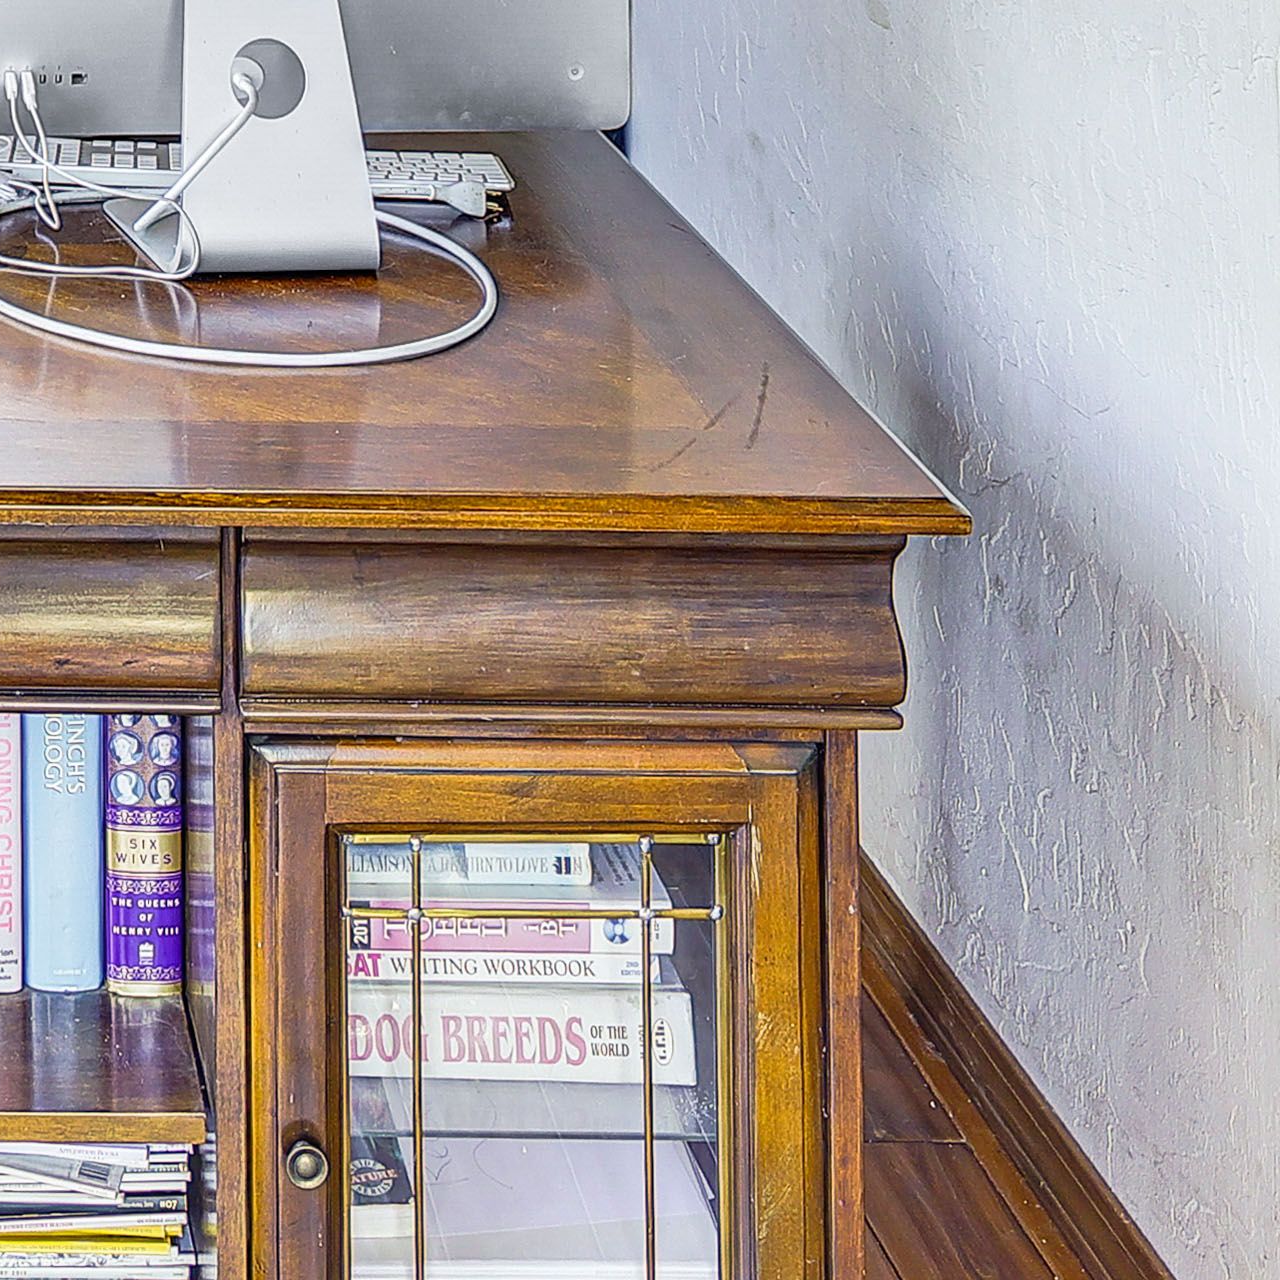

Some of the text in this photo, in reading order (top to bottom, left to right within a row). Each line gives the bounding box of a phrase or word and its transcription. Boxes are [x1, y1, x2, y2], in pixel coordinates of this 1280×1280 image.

[129, 837, 159, 850] SIX
[114, 851, 173, 865] WIVES
[496, 856, 513, 873] TO
[513, 855, 550, 873] LOVE
[110, 897, 181, 909] THE QUEENS
[138, 912, 154, 923] OF
[111, 925, 181, 936] HENRY VIII
[352, 917, 371, 945] 201
[389, 957, 479, 977] WITING
[483, 958, 597, 979] WORKBOOK
[348, 1013, 430, 1064] DOG
[440, 1014, 589, 1067] BREEDS
[590, 1025, 629, 1040] OF THE
[590, 1042, 631, 1058] WORLD
